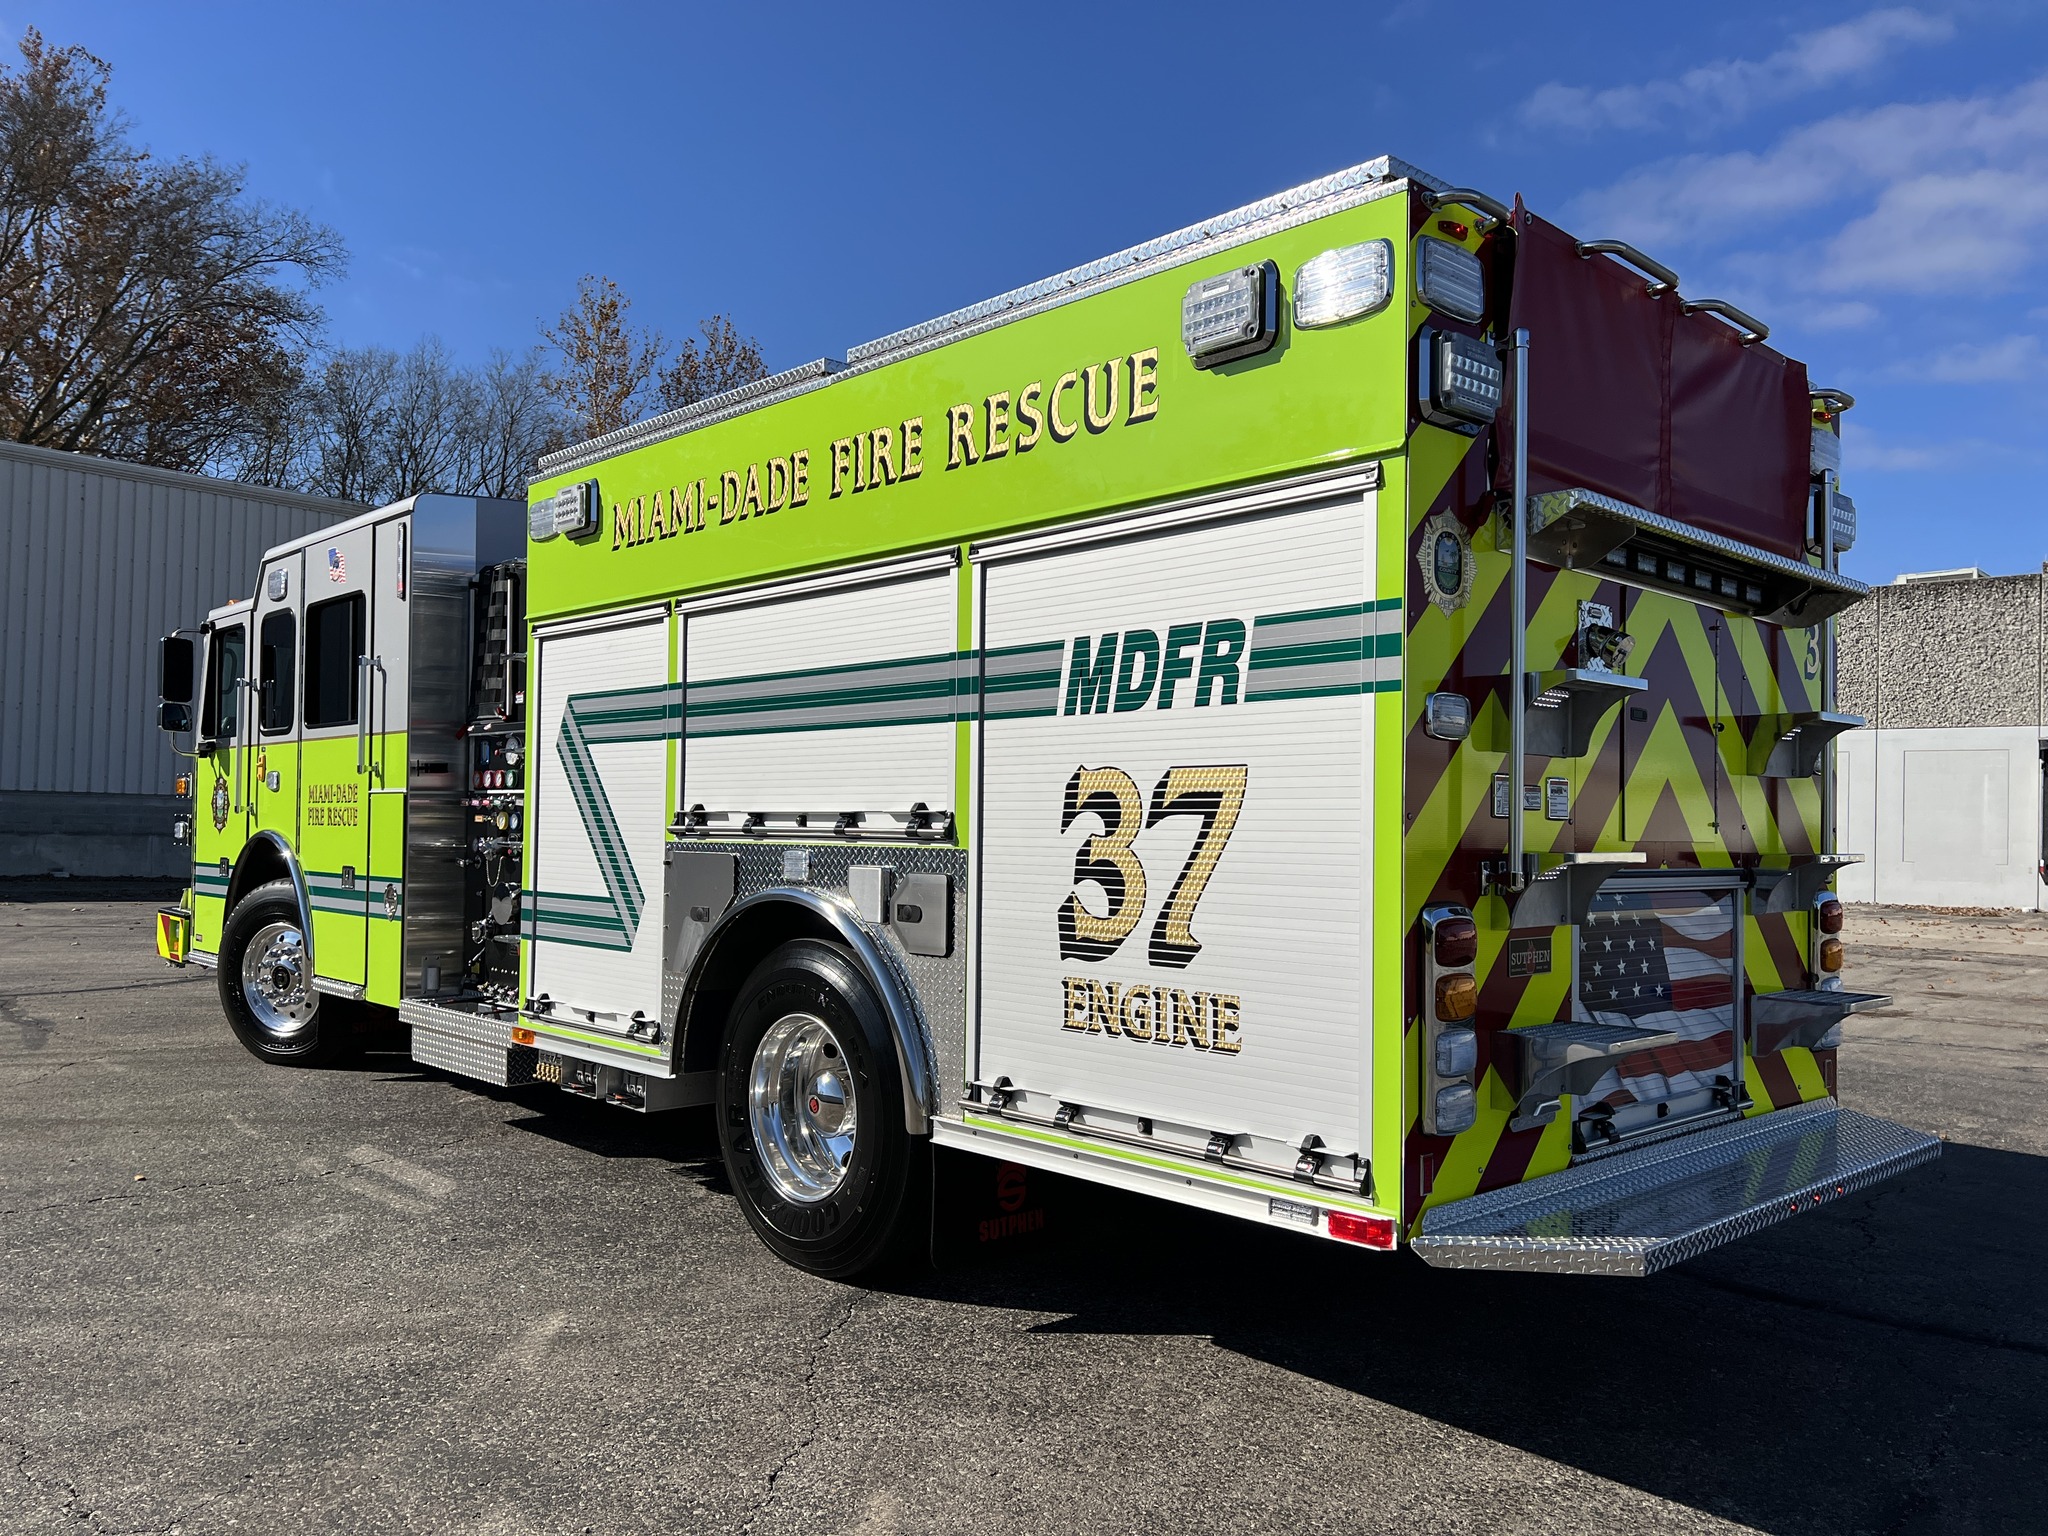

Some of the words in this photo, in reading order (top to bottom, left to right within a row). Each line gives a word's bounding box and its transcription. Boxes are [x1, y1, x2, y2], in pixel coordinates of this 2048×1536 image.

[612, 448, 811, 552] MIAMI-DADE
[830, 415, 925, 498] FIRE
[945, 346, 1161, 471] RESCUE
[1063, 617, 1247, 716] MDFR
[307, 806, 325, 826] FIRE
[327, 806, 358, 827] RESCUE
[308, 783, 358, 804] MIAMI-DADE
[1057, 763, 1249, 970] 37
[1511, 950, 1550, 966] SUTPHEN
[1061, 976, 1243, 1056] ENGINE
[979, 1208, 1044, 1243] SUTPHEN
